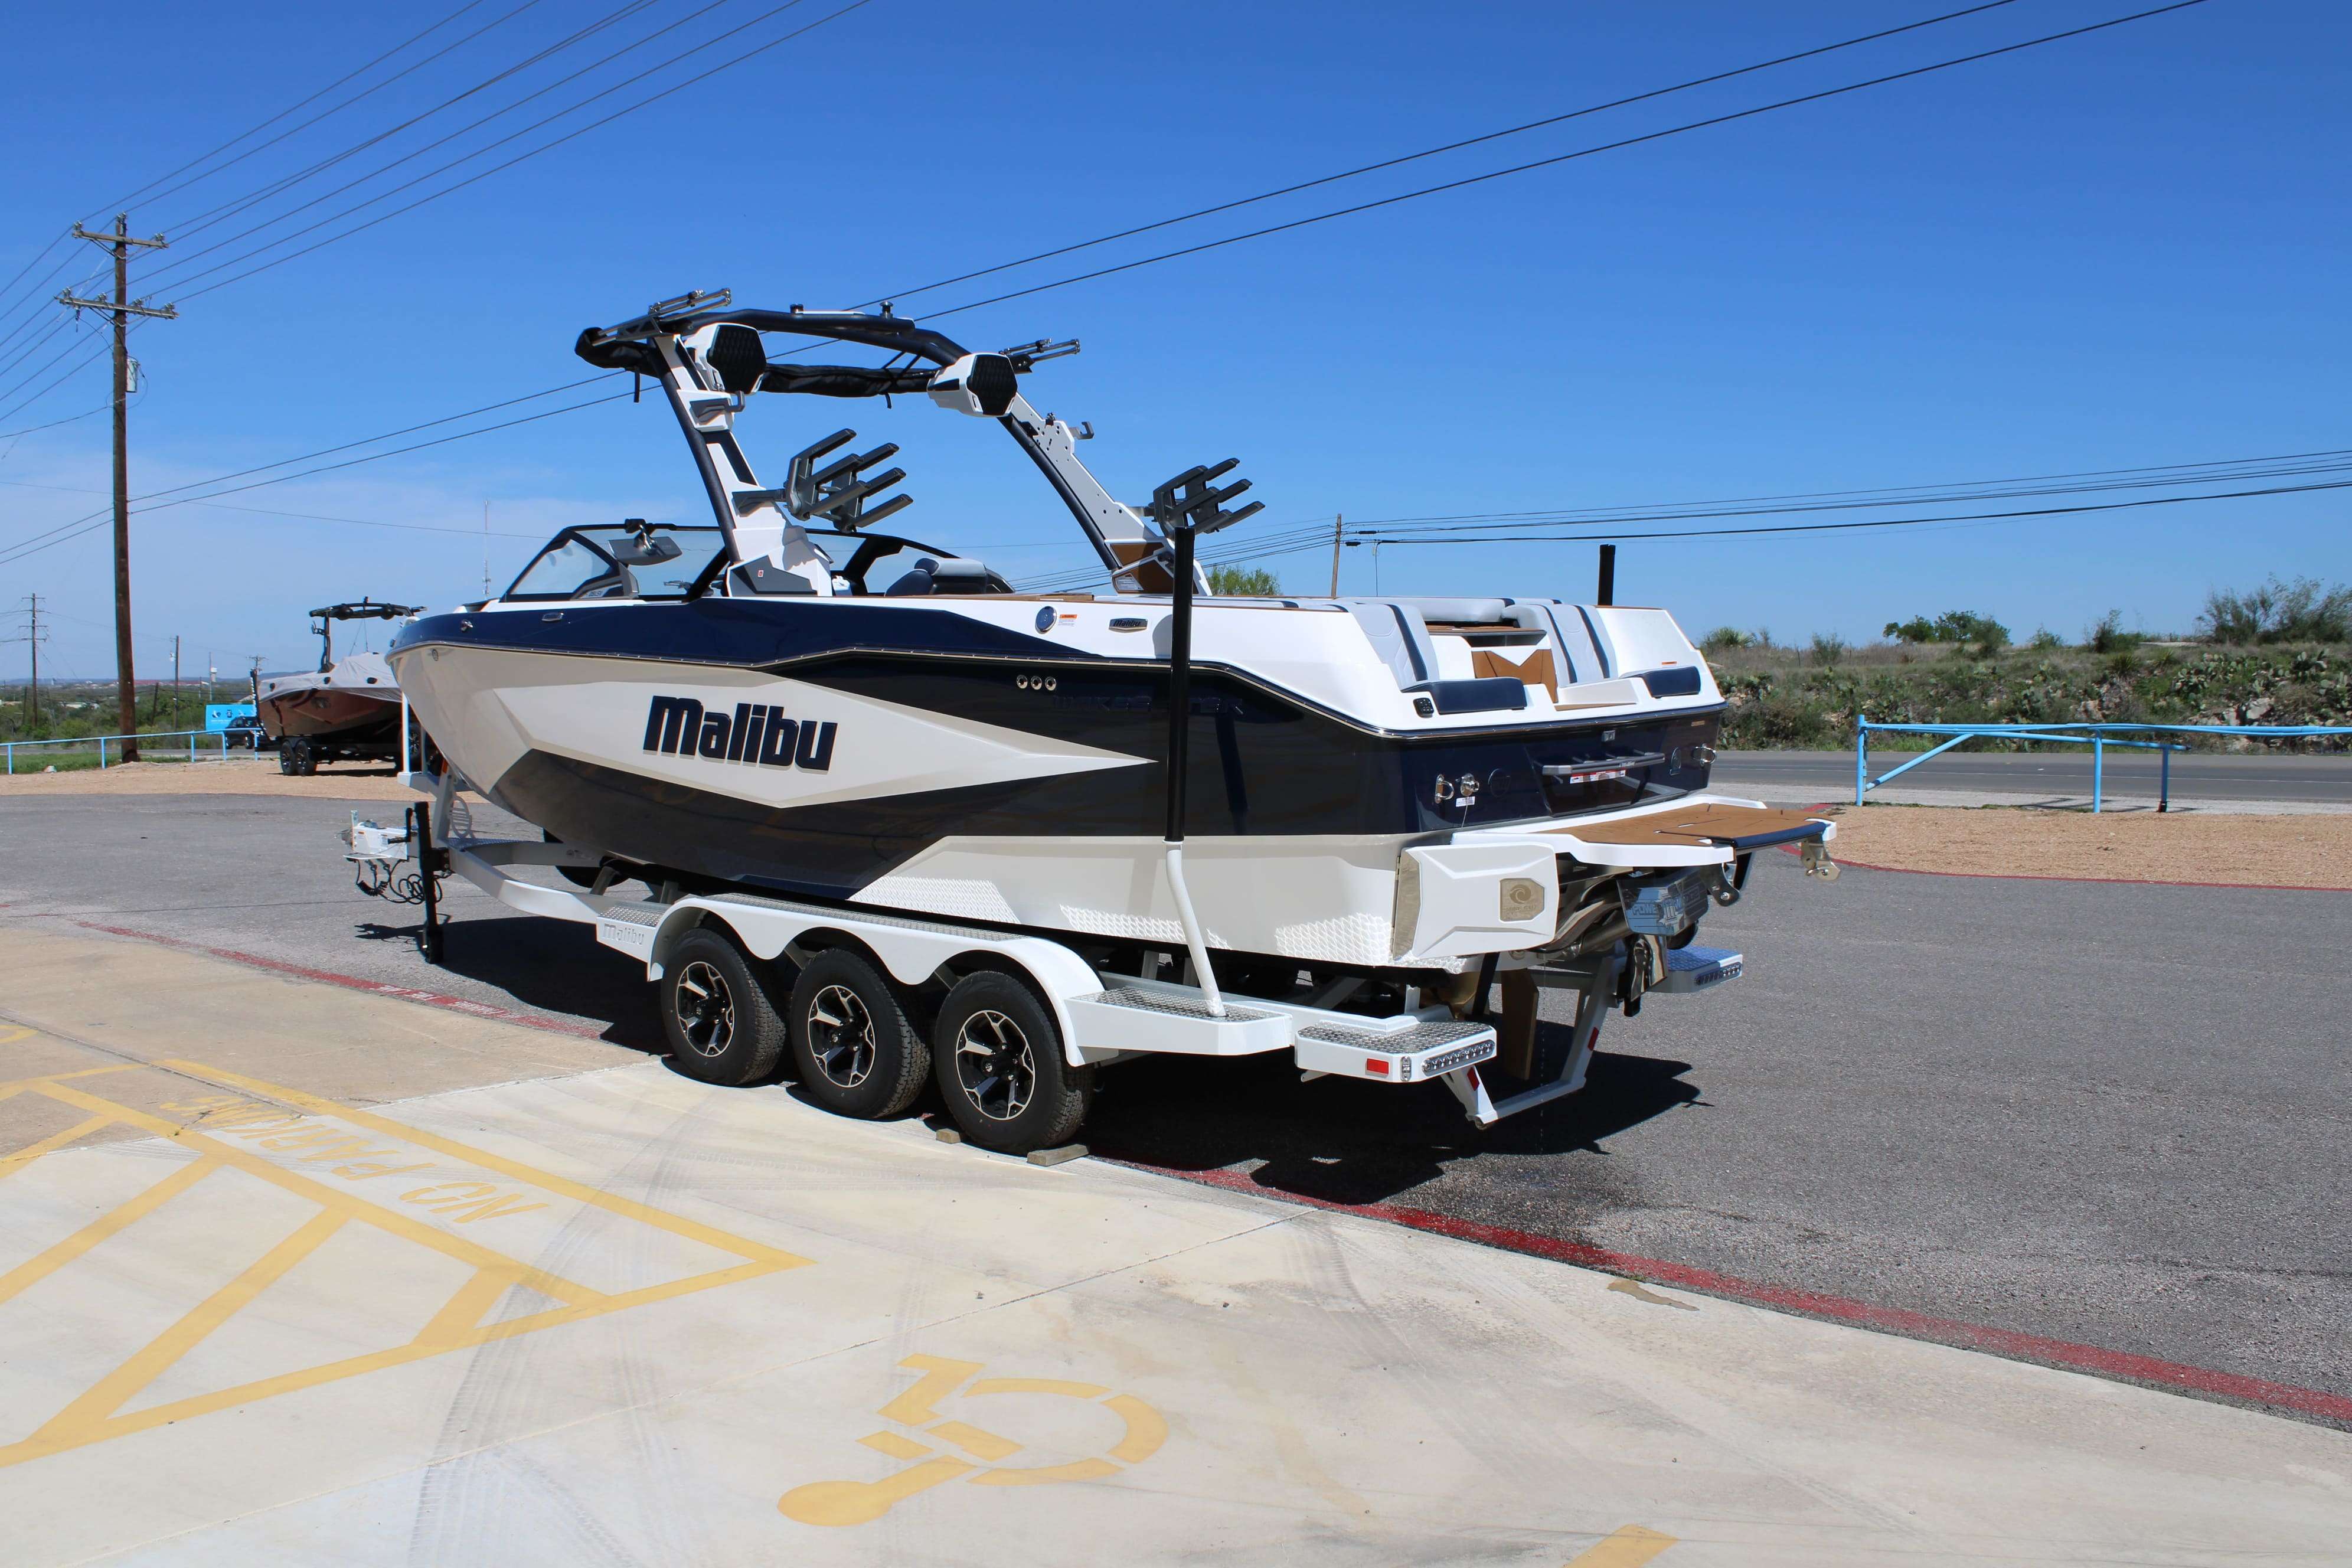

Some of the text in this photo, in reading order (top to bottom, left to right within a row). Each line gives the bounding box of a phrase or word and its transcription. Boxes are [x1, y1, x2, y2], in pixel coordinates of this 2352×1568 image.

[1113, 619, 1141, 628] Malibu
[1053, 695, 1244, 714] WAKESTER
[642, 695, 838, 772] Malibu
[603, 923, 645, 946] Malibu
[160, 1095, 549, 1223] NO PARKING
